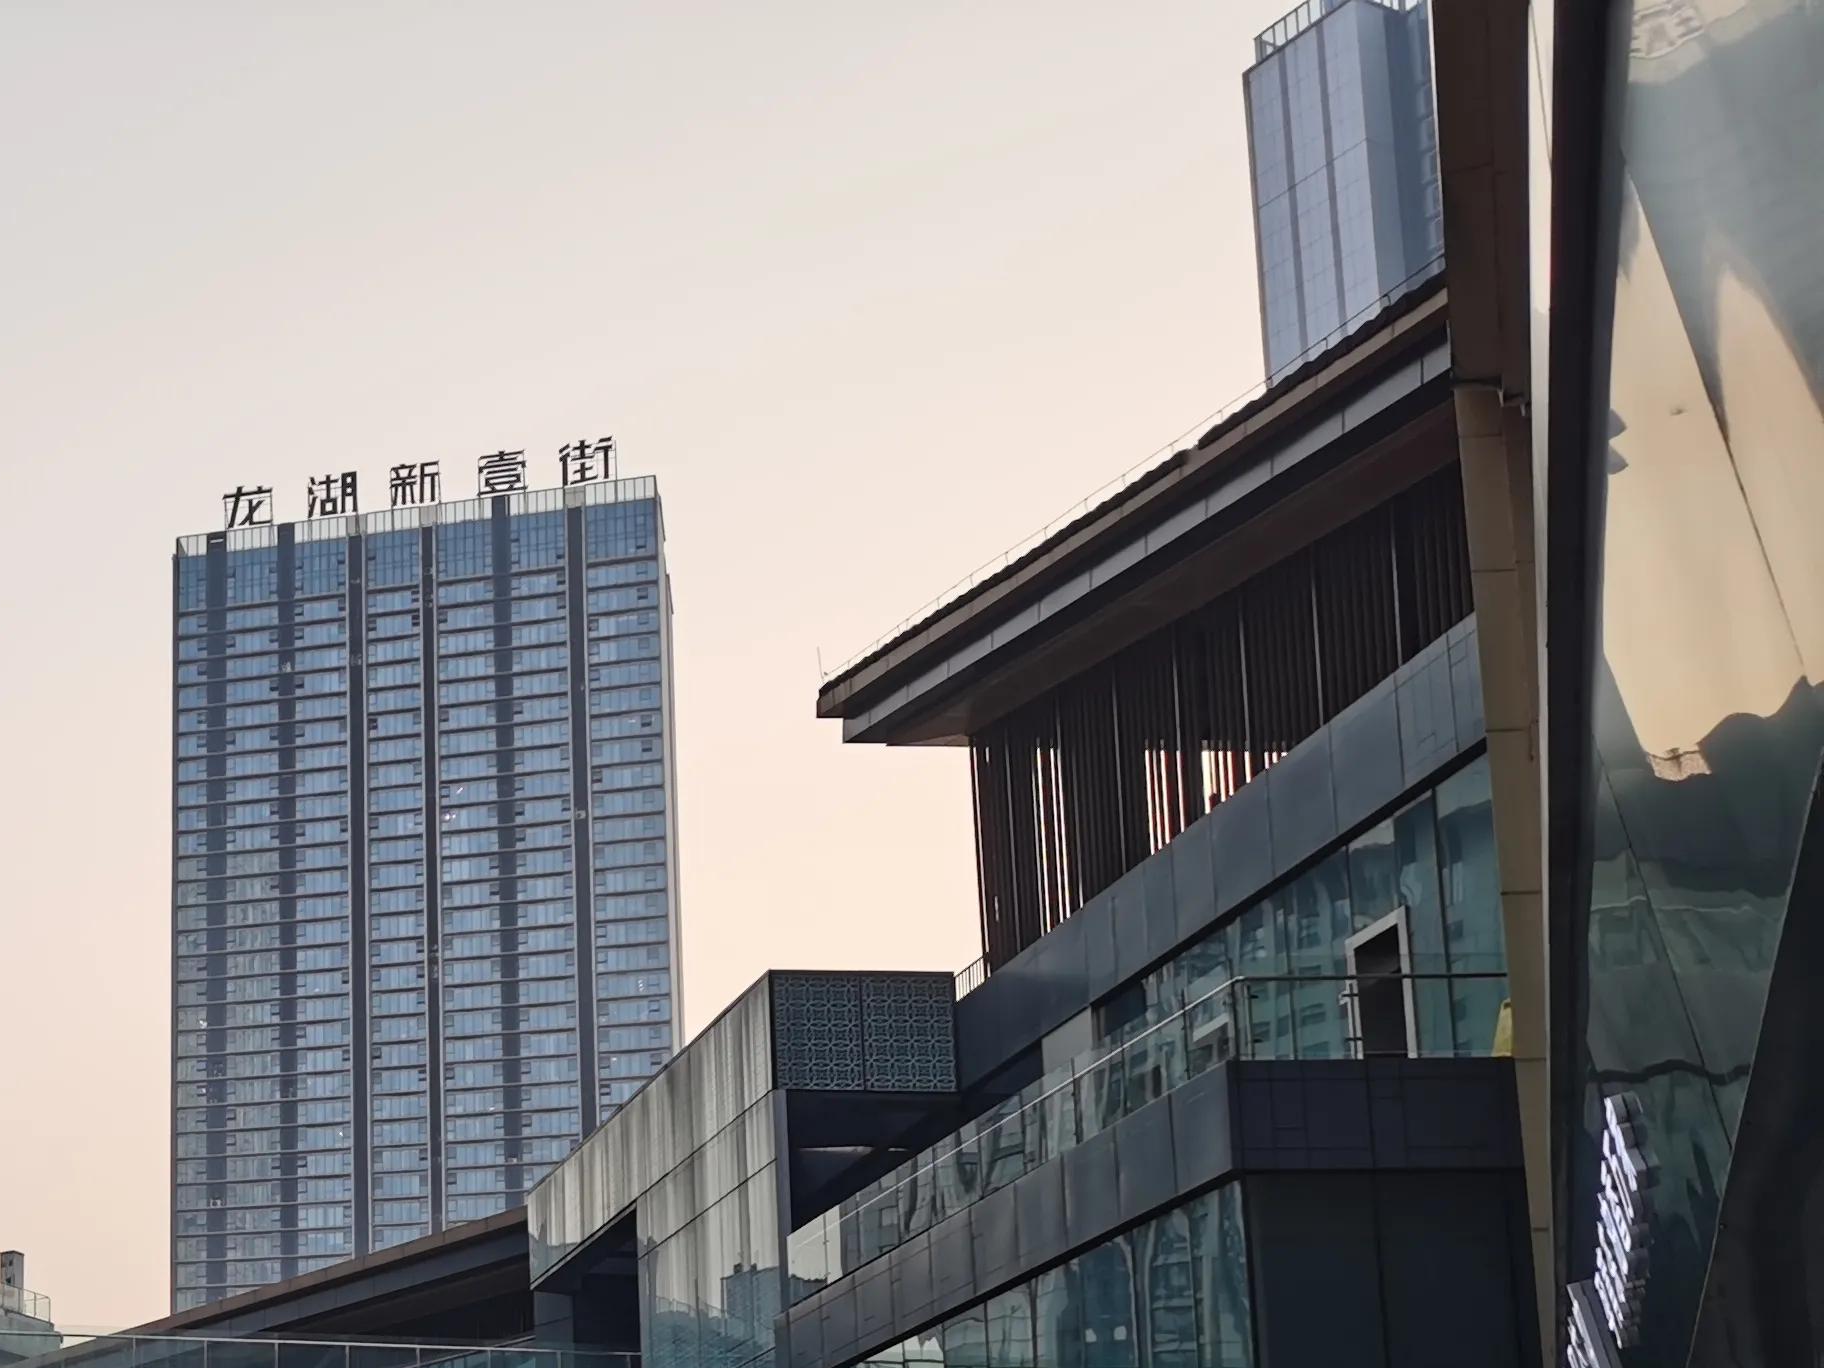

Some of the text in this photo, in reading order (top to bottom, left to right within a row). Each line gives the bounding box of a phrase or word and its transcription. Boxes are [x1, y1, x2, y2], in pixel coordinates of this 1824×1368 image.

[222, 436, 616, 528] 龙湖新壹街
